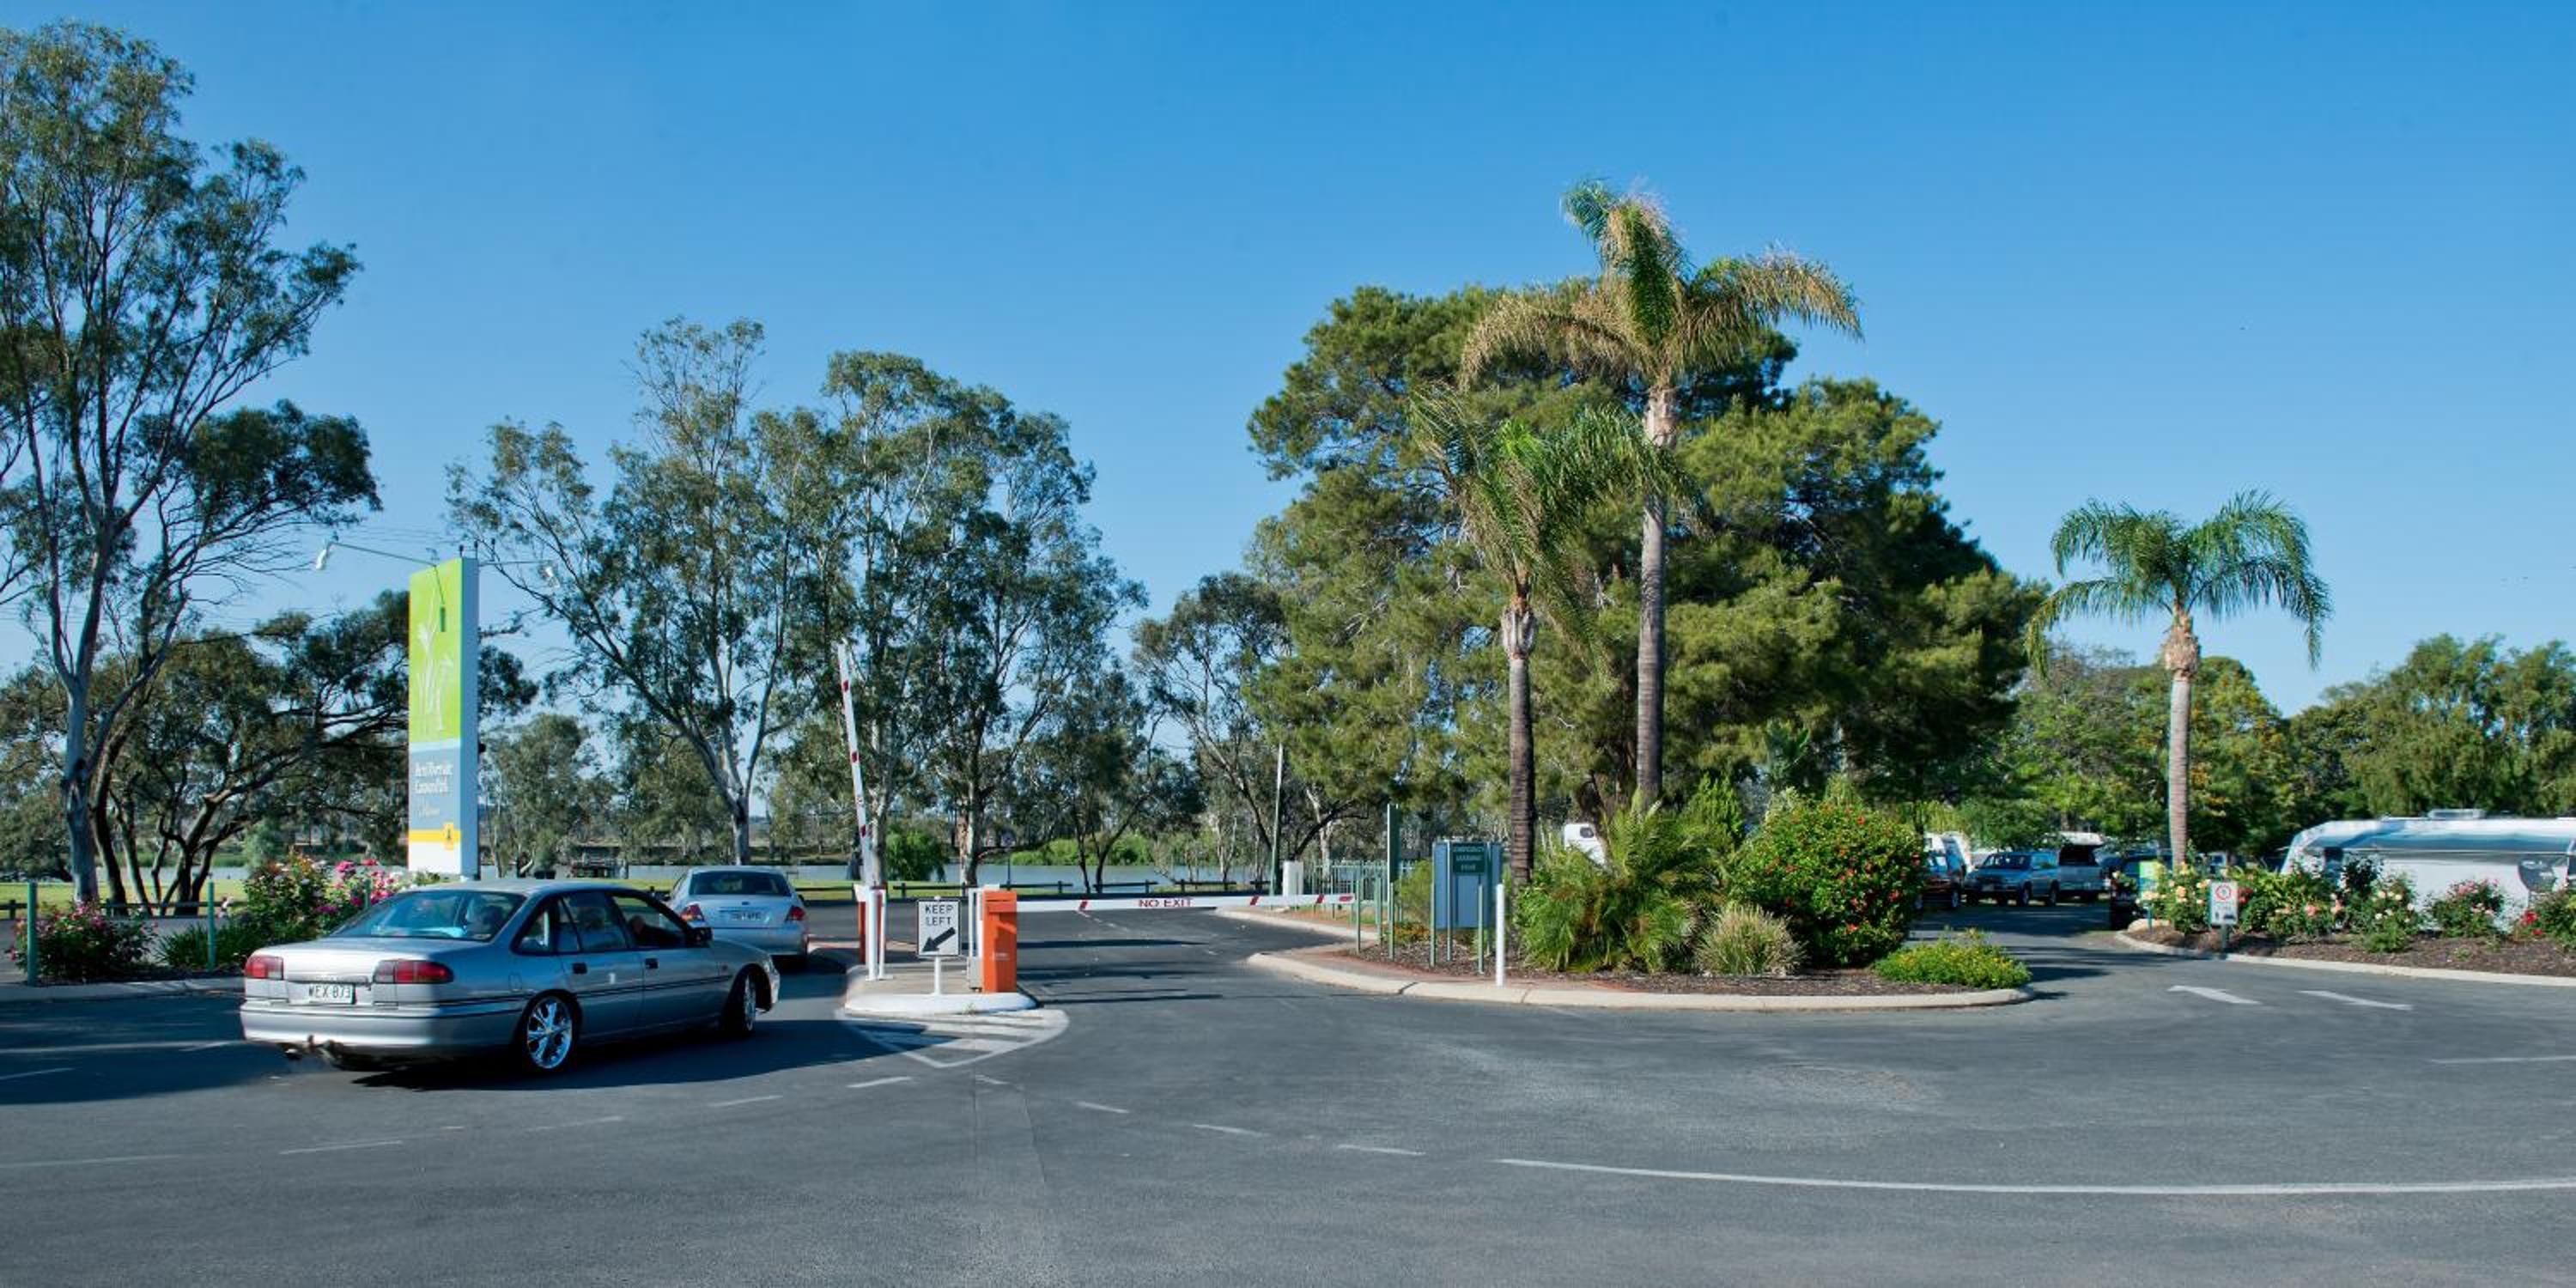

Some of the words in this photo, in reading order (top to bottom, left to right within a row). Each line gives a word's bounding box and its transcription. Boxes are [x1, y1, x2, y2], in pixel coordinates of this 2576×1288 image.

[1139, 899, 1160, 908] NO
[1163, 898, 1192, 908] EXIT
[925, 904, 954, 914] KEEP
[926, 916, 951, 927] LEFT
